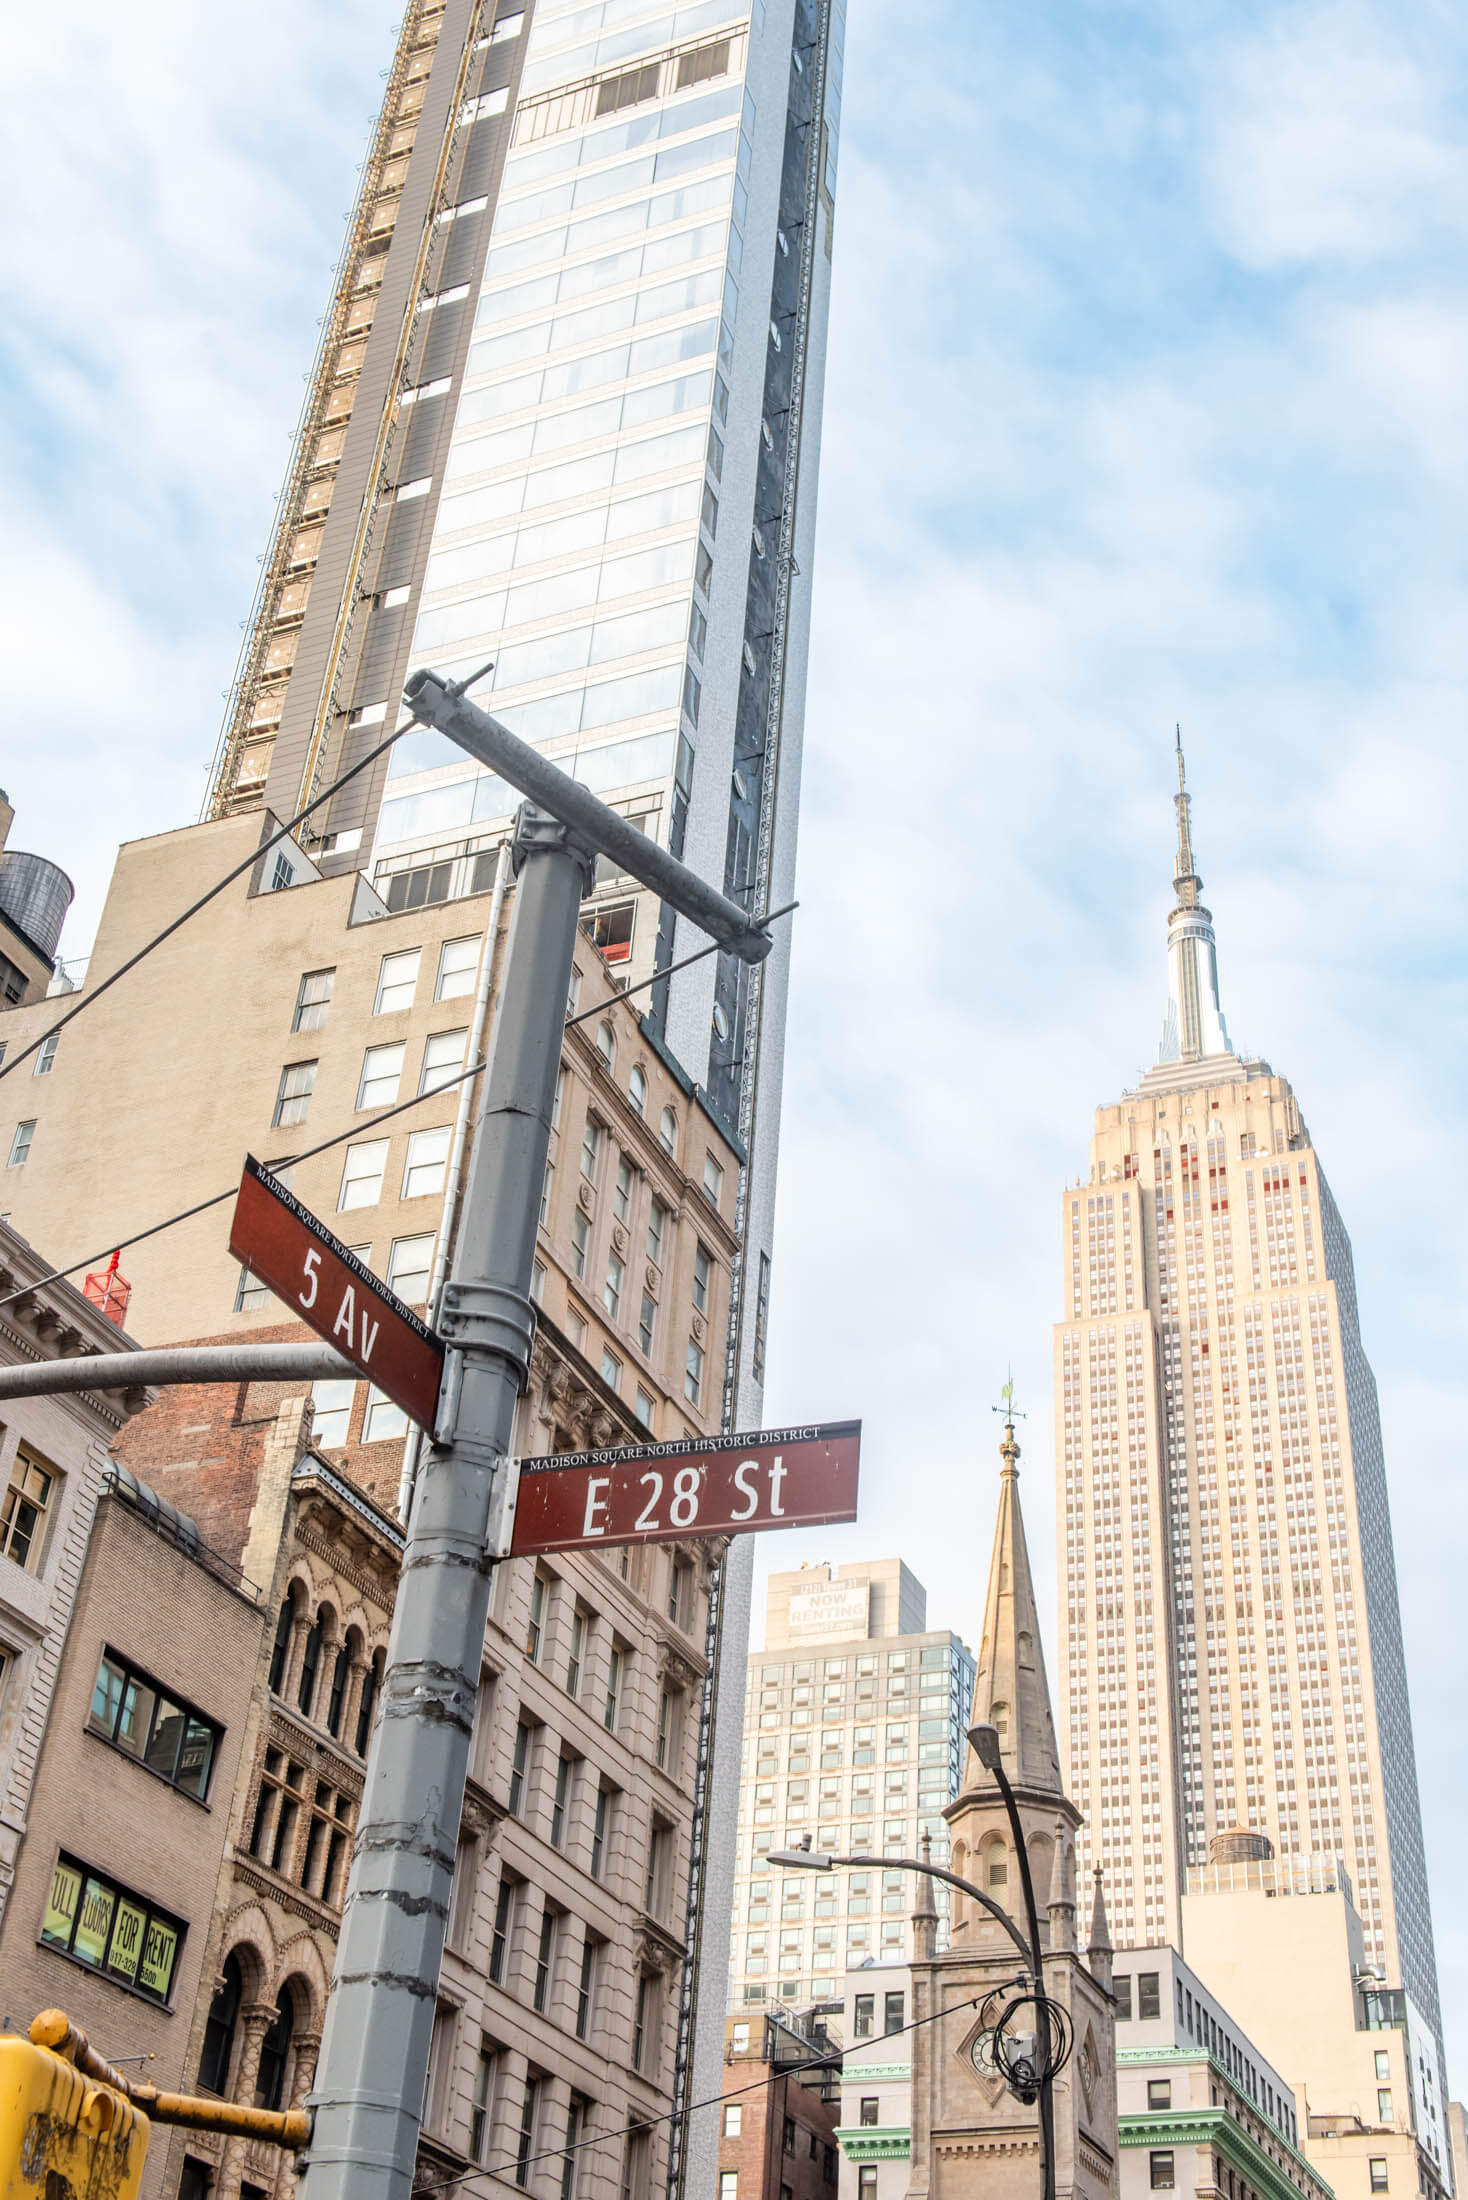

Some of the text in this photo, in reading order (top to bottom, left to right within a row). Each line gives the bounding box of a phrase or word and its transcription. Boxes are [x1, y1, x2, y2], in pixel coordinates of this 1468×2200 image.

[256, 1167, 429, 1337] MADISON SQUARE NORTH HISTORIC DISTRICT
[298, 1247, 322, 1309] 5
[529, 1425, 821, 1472] MADISON SQUARE NORTH HISTORIC DISTRICT
[582, 1455, 788, 1537] E 28 St
[792, 1603, 864, 1623] RENTING
[809, 1592, 848, 1608] NOW
[51, 1872, 75, 1920] ULL
[116, 1911, 139, 1953] FOR
[145, 1928, 174, 1971] RENT
